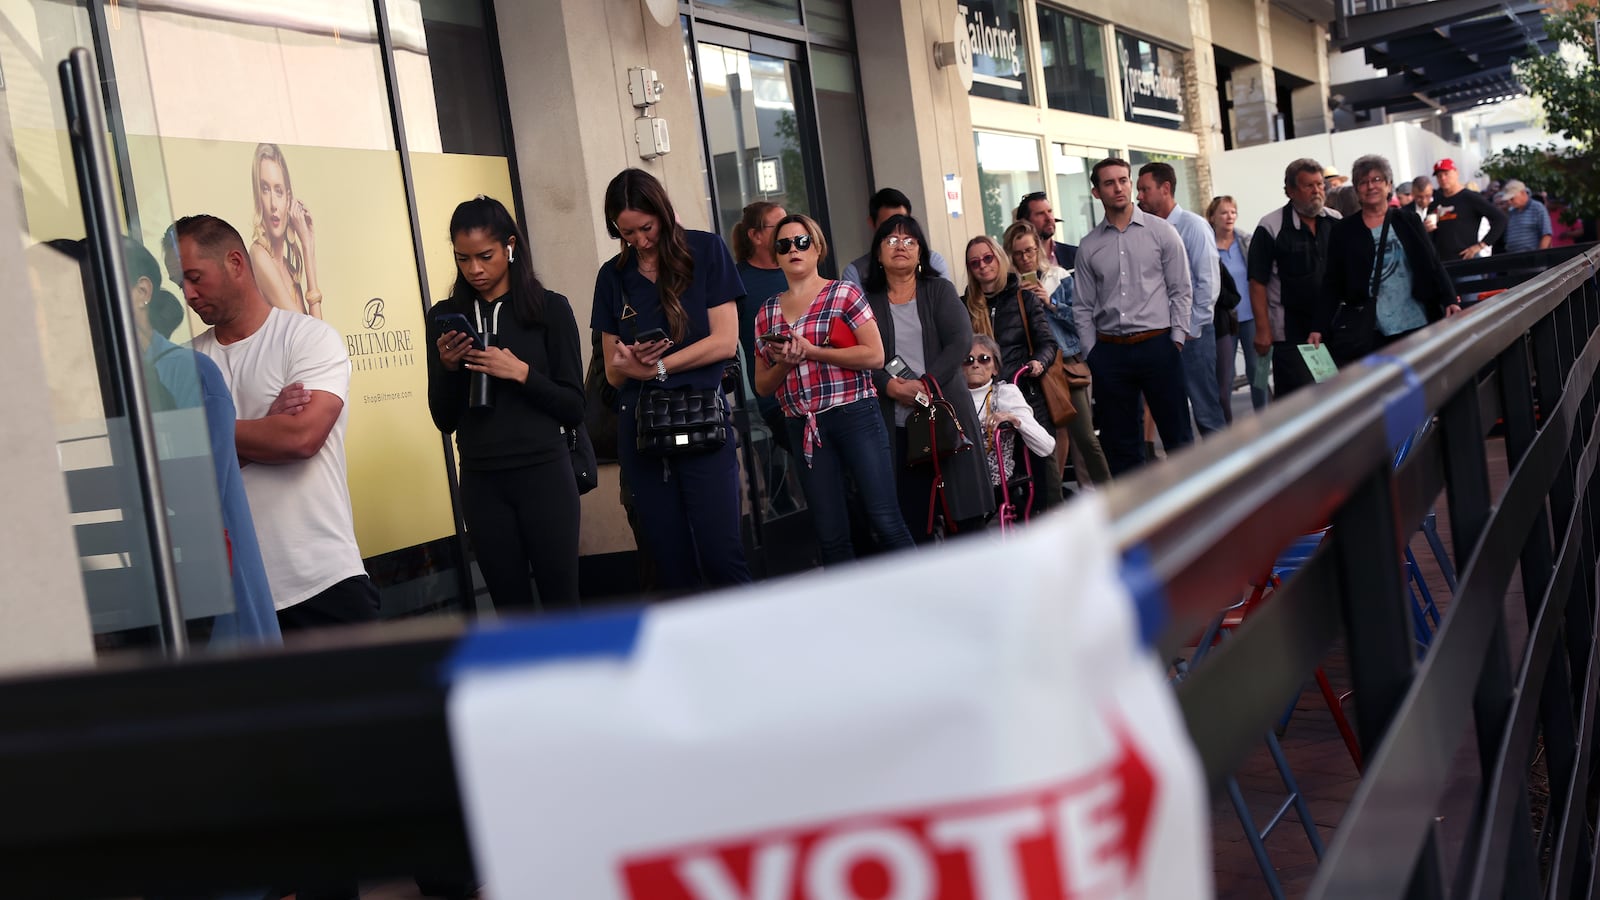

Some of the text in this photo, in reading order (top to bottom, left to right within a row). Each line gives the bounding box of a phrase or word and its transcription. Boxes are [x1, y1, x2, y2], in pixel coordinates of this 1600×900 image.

[958, 4, 1020, 77] Tailoring
[346, 330, 414, 357] BILTMORE
[363, 391, 413, 404] ShopBiltmore.com
[673, 777, 1127, 900] VOTE
